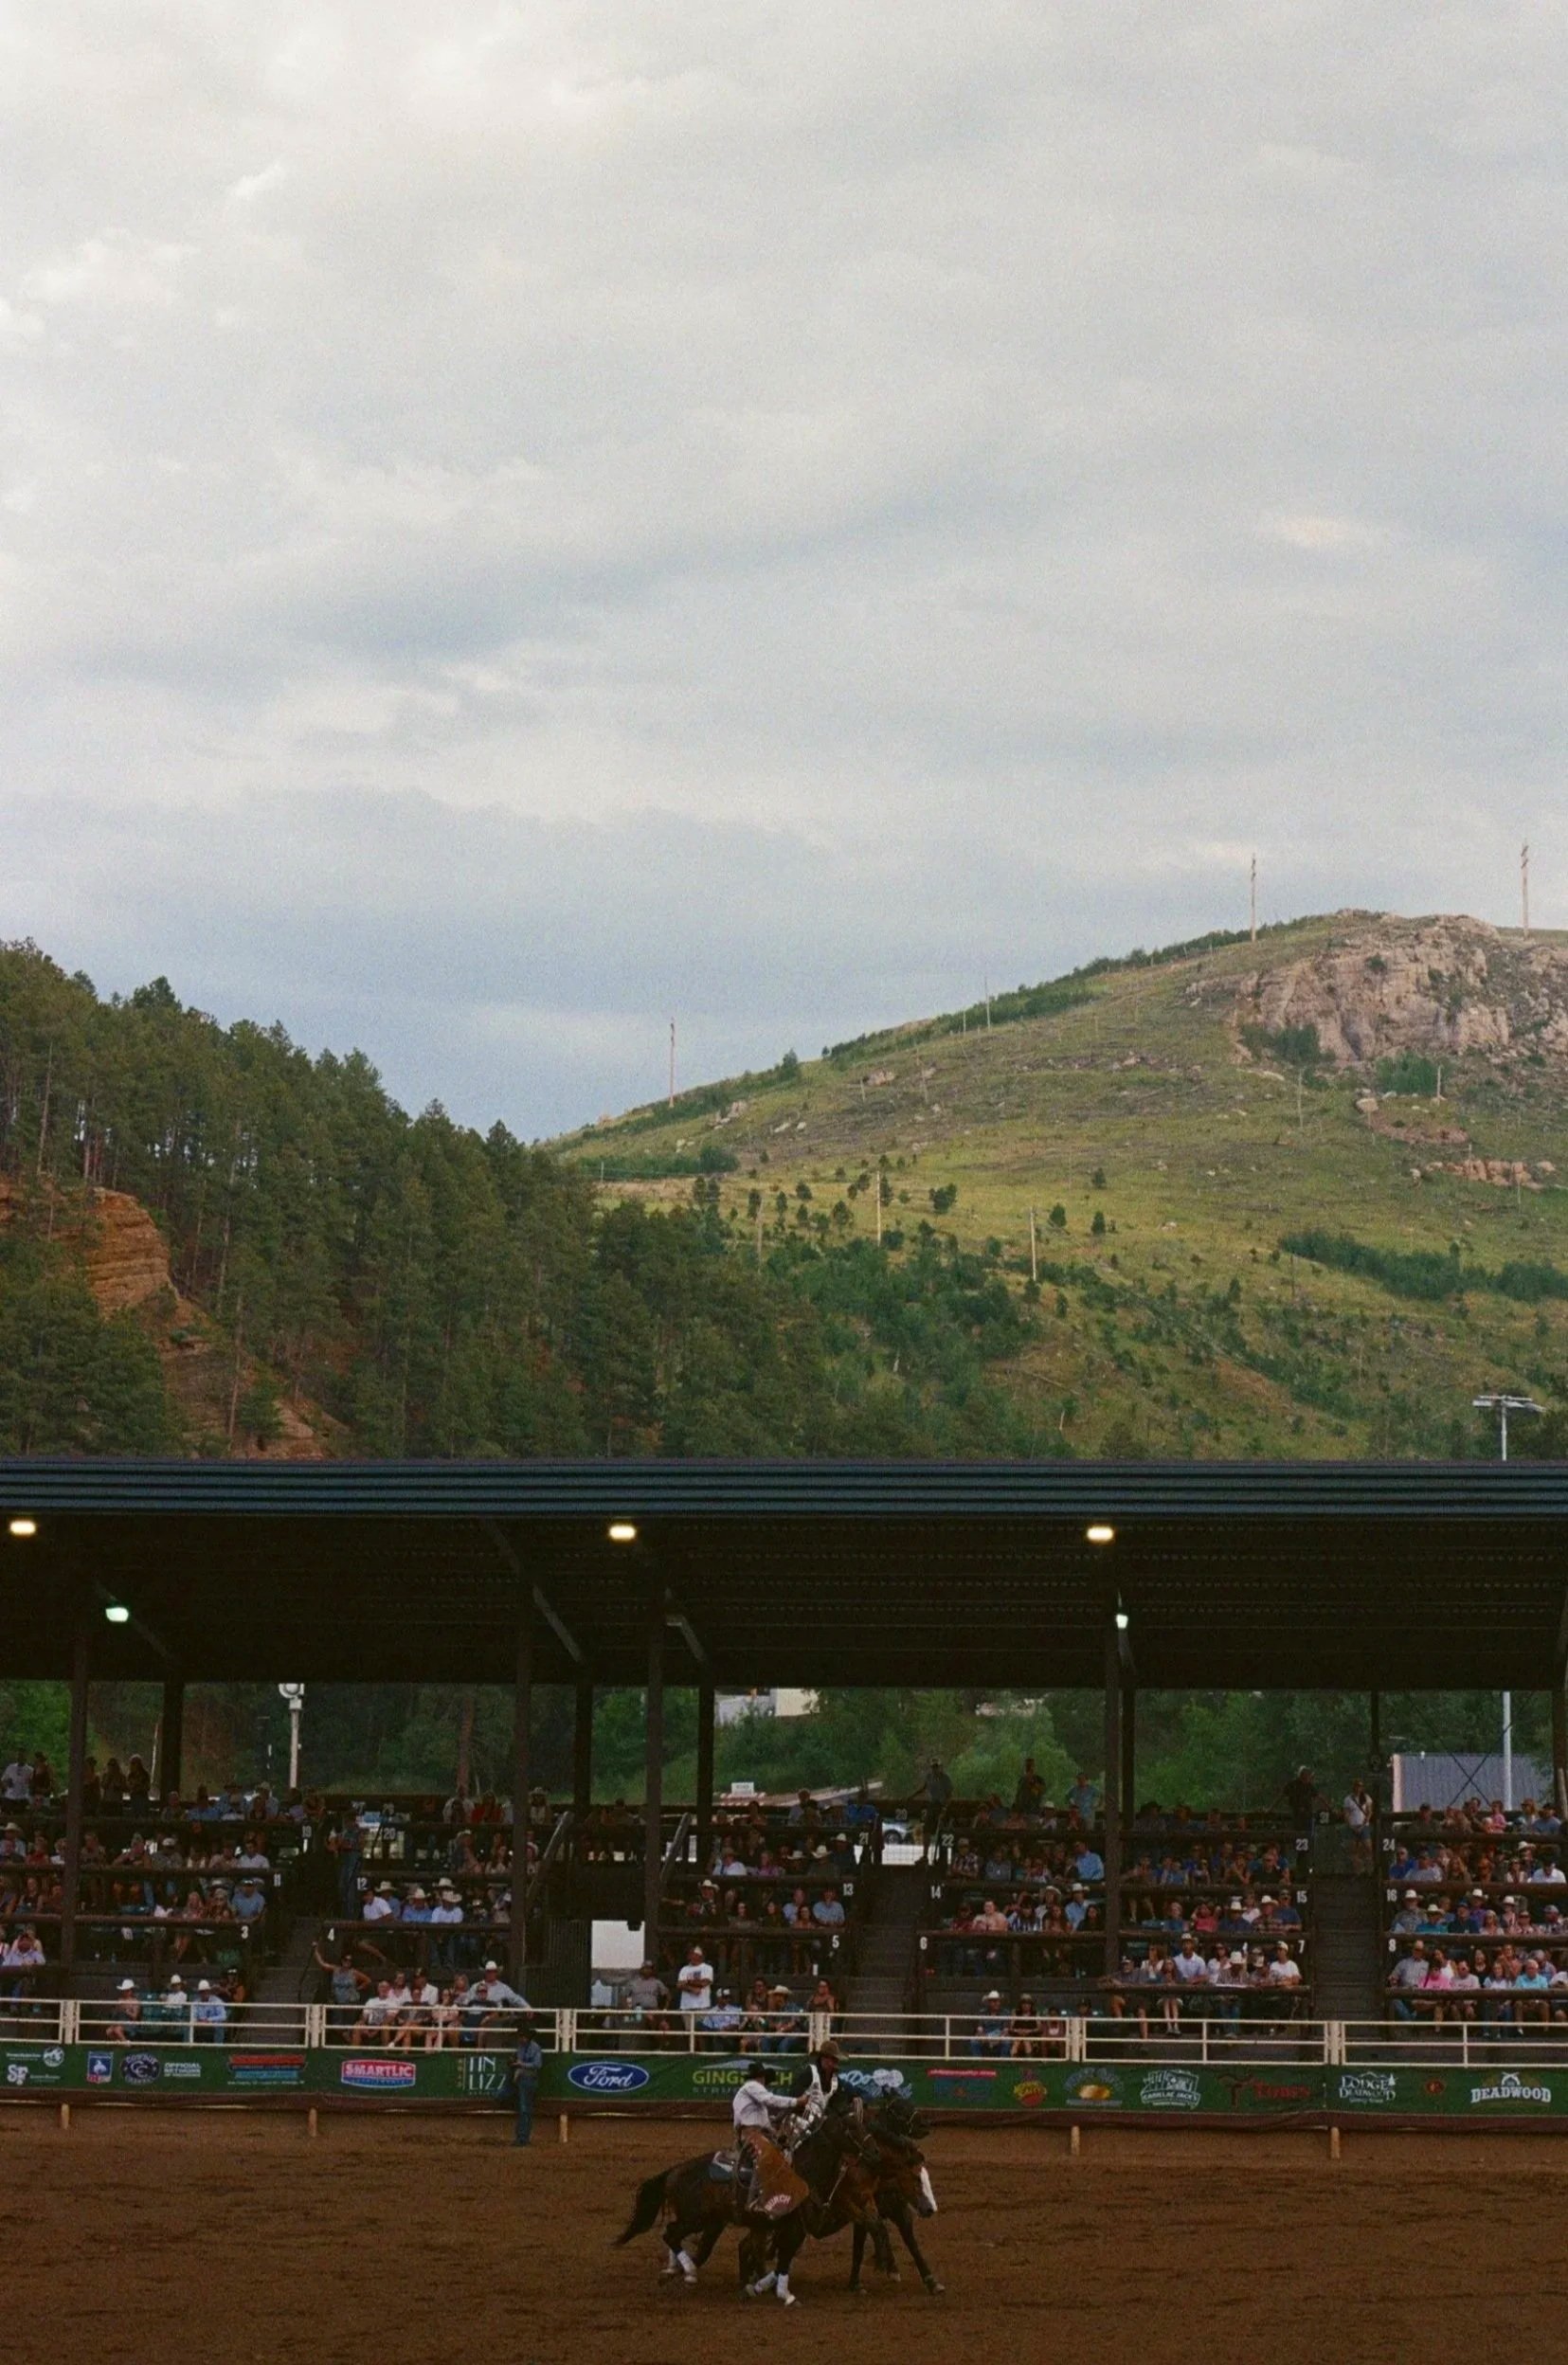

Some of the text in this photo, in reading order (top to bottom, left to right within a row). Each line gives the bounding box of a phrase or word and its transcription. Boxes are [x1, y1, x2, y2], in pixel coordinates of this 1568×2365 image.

[858, 1832, 870, 1846] 21
[941, 1833, 955, 1847] 22
[1295, 1838, 1308, 1851] 23
[1382, 1838, 1396, 1851] 24
[273, 1873, 281, 1887] 11
[356, 1877, 368, 1890] 12
[842, 1883, 854, 1896] 13
[930, 1885, 942, 1900] 14
[1295, 1890, 1307, 1904] 15
[241, 1924, 249, 1940] 3
[327, 1927, 334, 1941] 4
[831, 1935, 839, 1949] 5
[919, 1936, 928, 1950] 6
[1297, 1939, 1306, 1954] 7
[1388, 1939, 1397, 1953] 8
[345, 2064, 412, 2077] SMARTLIC
[468, 2055, 496, 2072] TIN
[584, 2066, 634, 2087] Ford
[1341, 2074, 1389, 2090] LODGE
[1470, 2086, 1552, 2103] DEADWOOD
[764, 2193, 792, 2212] BURCH
